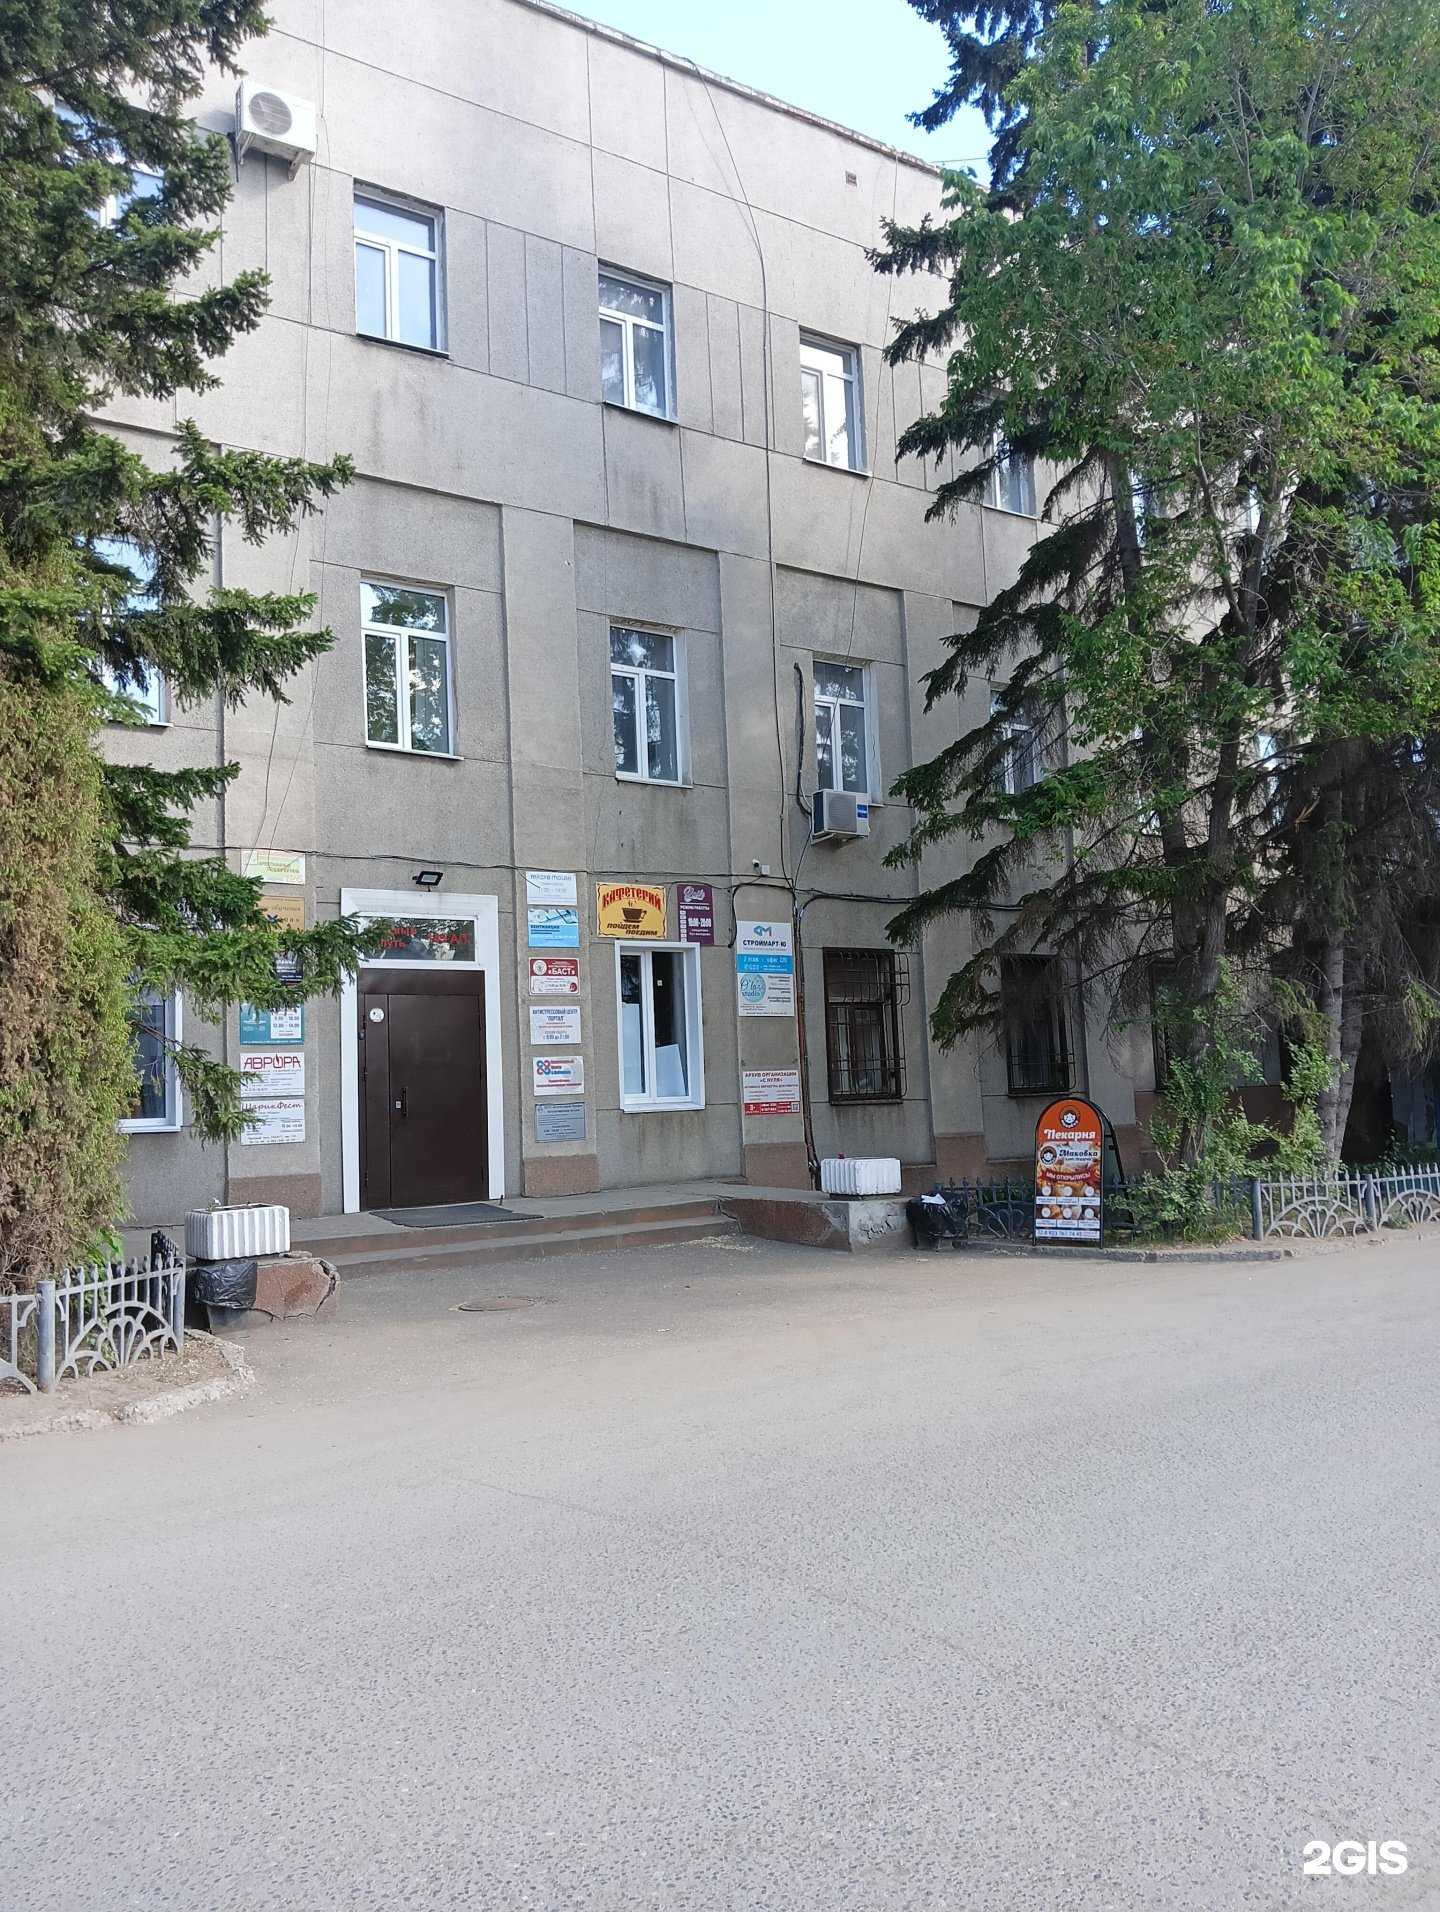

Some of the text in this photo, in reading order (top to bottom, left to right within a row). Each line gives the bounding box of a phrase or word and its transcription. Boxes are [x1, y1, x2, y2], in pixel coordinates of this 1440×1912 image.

[244, 1053, 301, 1070] АВРОРА
[1044, 1129, 1096, 1141] Пекарня
[1059, 1149, 1098, 1157] Маковка
